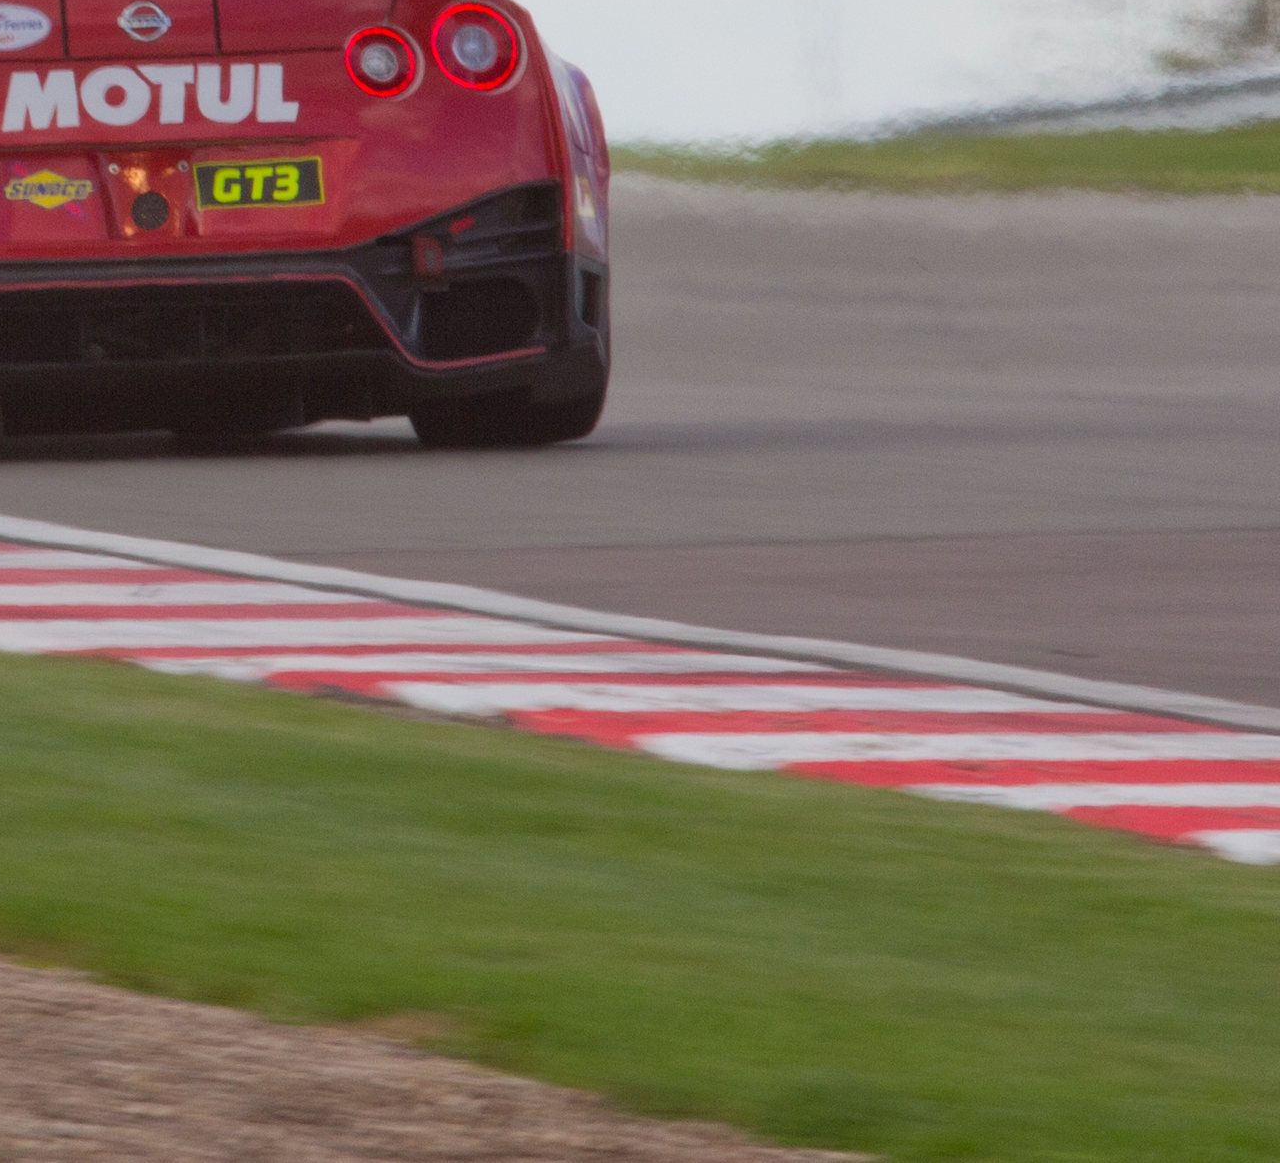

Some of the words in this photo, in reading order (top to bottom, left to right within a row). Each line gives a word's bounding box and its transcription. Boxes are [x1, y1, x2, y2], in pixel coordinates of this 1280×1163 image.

[4, 19, 44, 32] Ferries
[1, 63, 299, 132] MOTUL
[8, 181, 90, 199] SUNOCO
[212, 164, 300, 203] GT3
